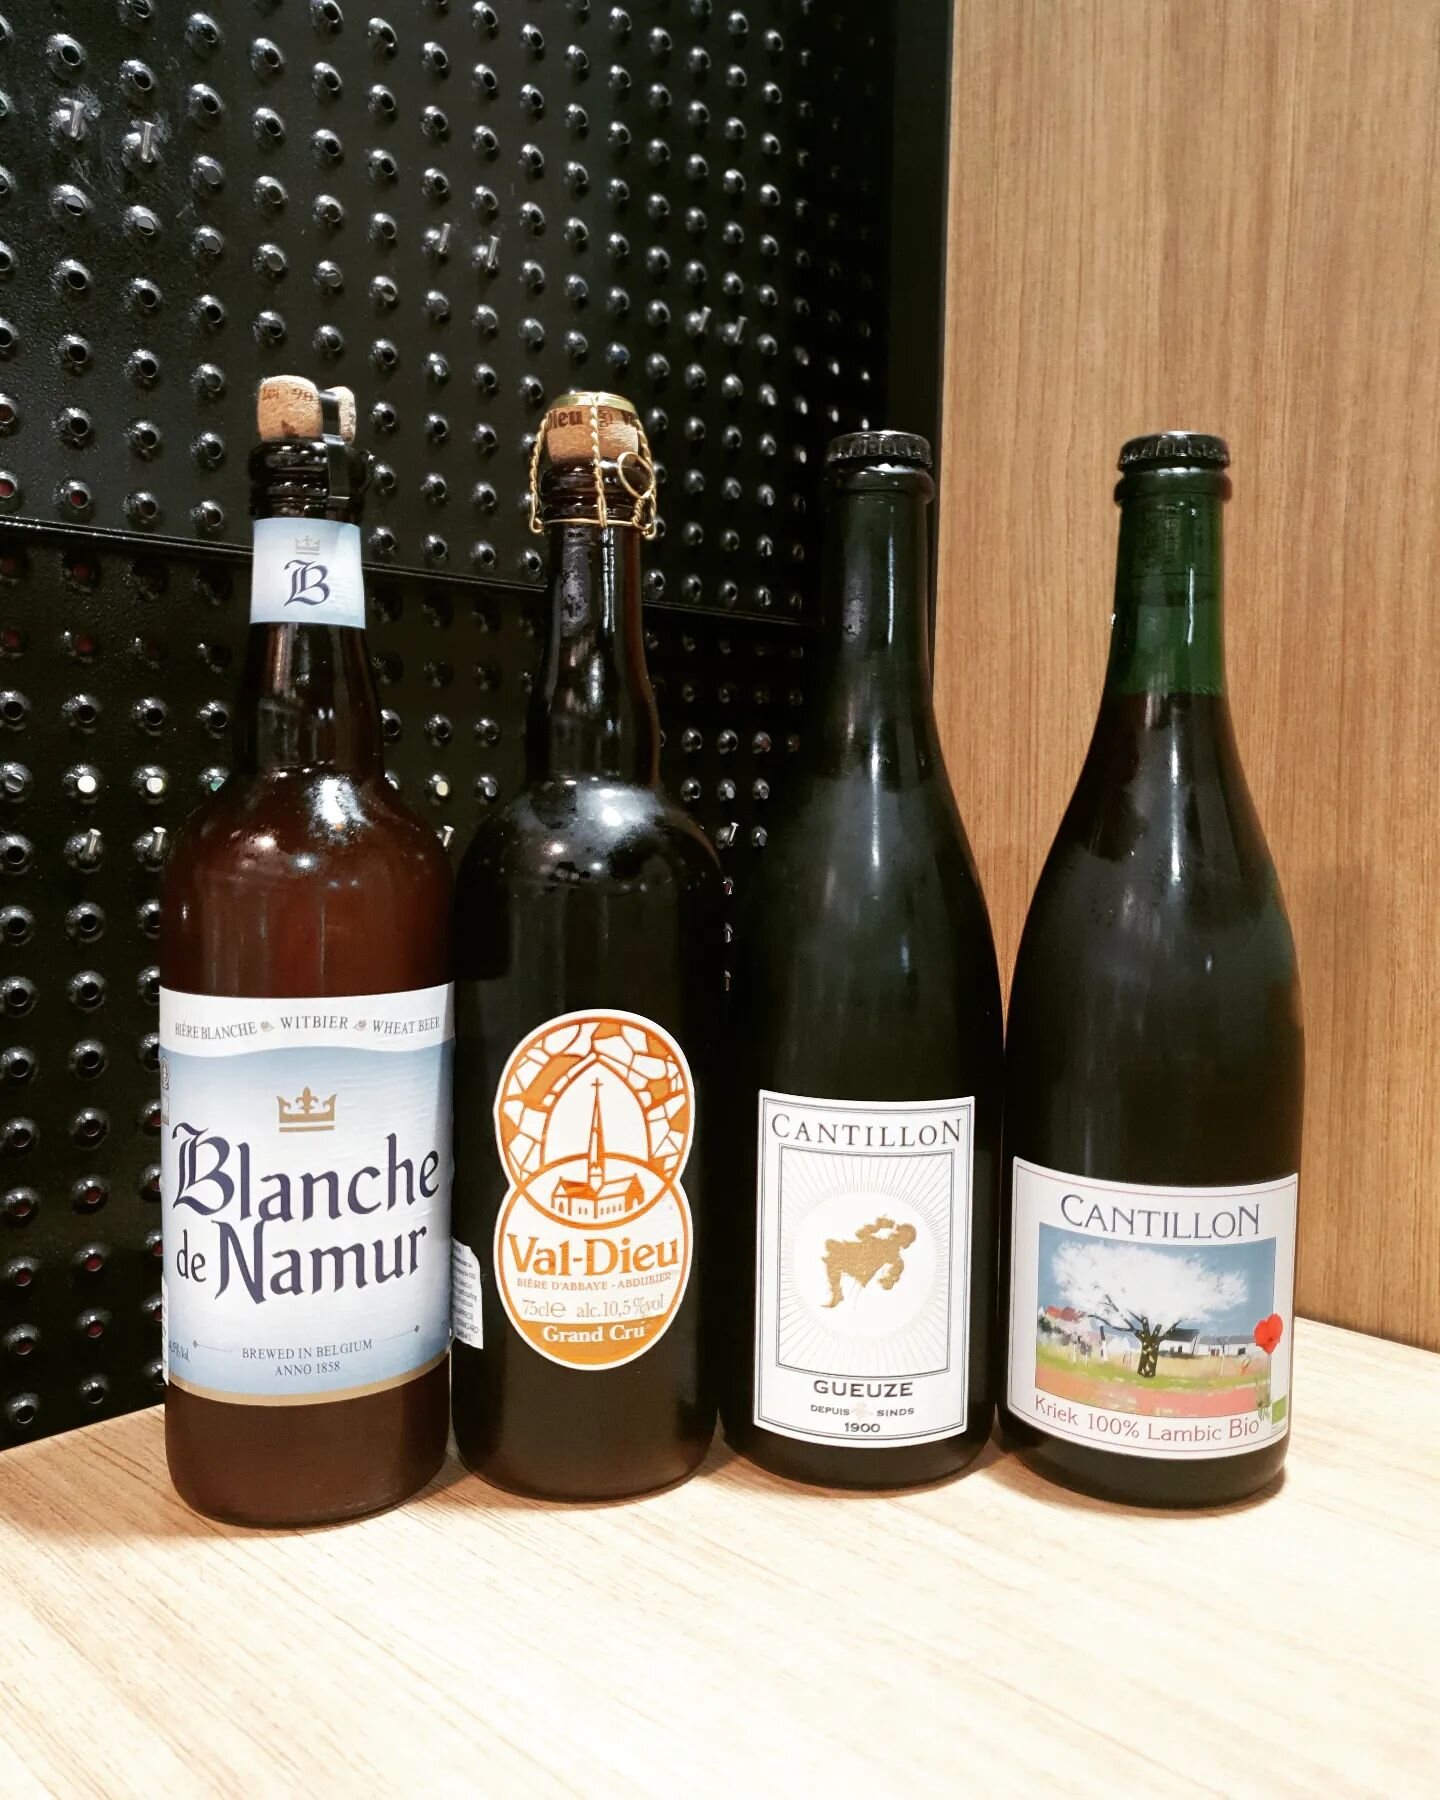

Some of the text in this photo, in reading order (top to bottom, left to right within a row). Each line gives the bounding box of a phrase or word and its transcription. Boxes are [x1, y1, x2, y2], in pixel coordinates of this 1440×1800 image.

[284, 560, 330, 607] B
[175, 1015, 441, 1040] BIÈRE BLANCHE WITBIER WHEAT BEER
[771, 1113, 962, 1147] CANTILLON
[172, 1122, 440, 1222] Blanche
[1061, 1194, 1259, 1239] CANTILLON
[176, 1219, 428, 1304] de Namur
[507, 1234, 679, 1276] Val-Dieu
[517, 1278, 549, 1290] BIÈRE
[551, 1281, 608, 1291] D'ABBAYE
[543, 1324, 645, 1343] Grand Cru
[242, 1339, 372, 1360] BREWED IN BELGIUM
[275, 1361, 341, 1376] ANNO 1858
[813, 1380, 913, 1398] GUEUZE
[810, 1404, 915, 1417] DEPUIS SINDS
[1035, 1395, 1078, 1425] Kriek
[1087, 1413, 1140, 1439] 100%
[1147, 1423, 1222, 1442] Lambic
[1228, 1418, 1259, 1439] Bio
[844, 1423, 880, 1434] 1900
